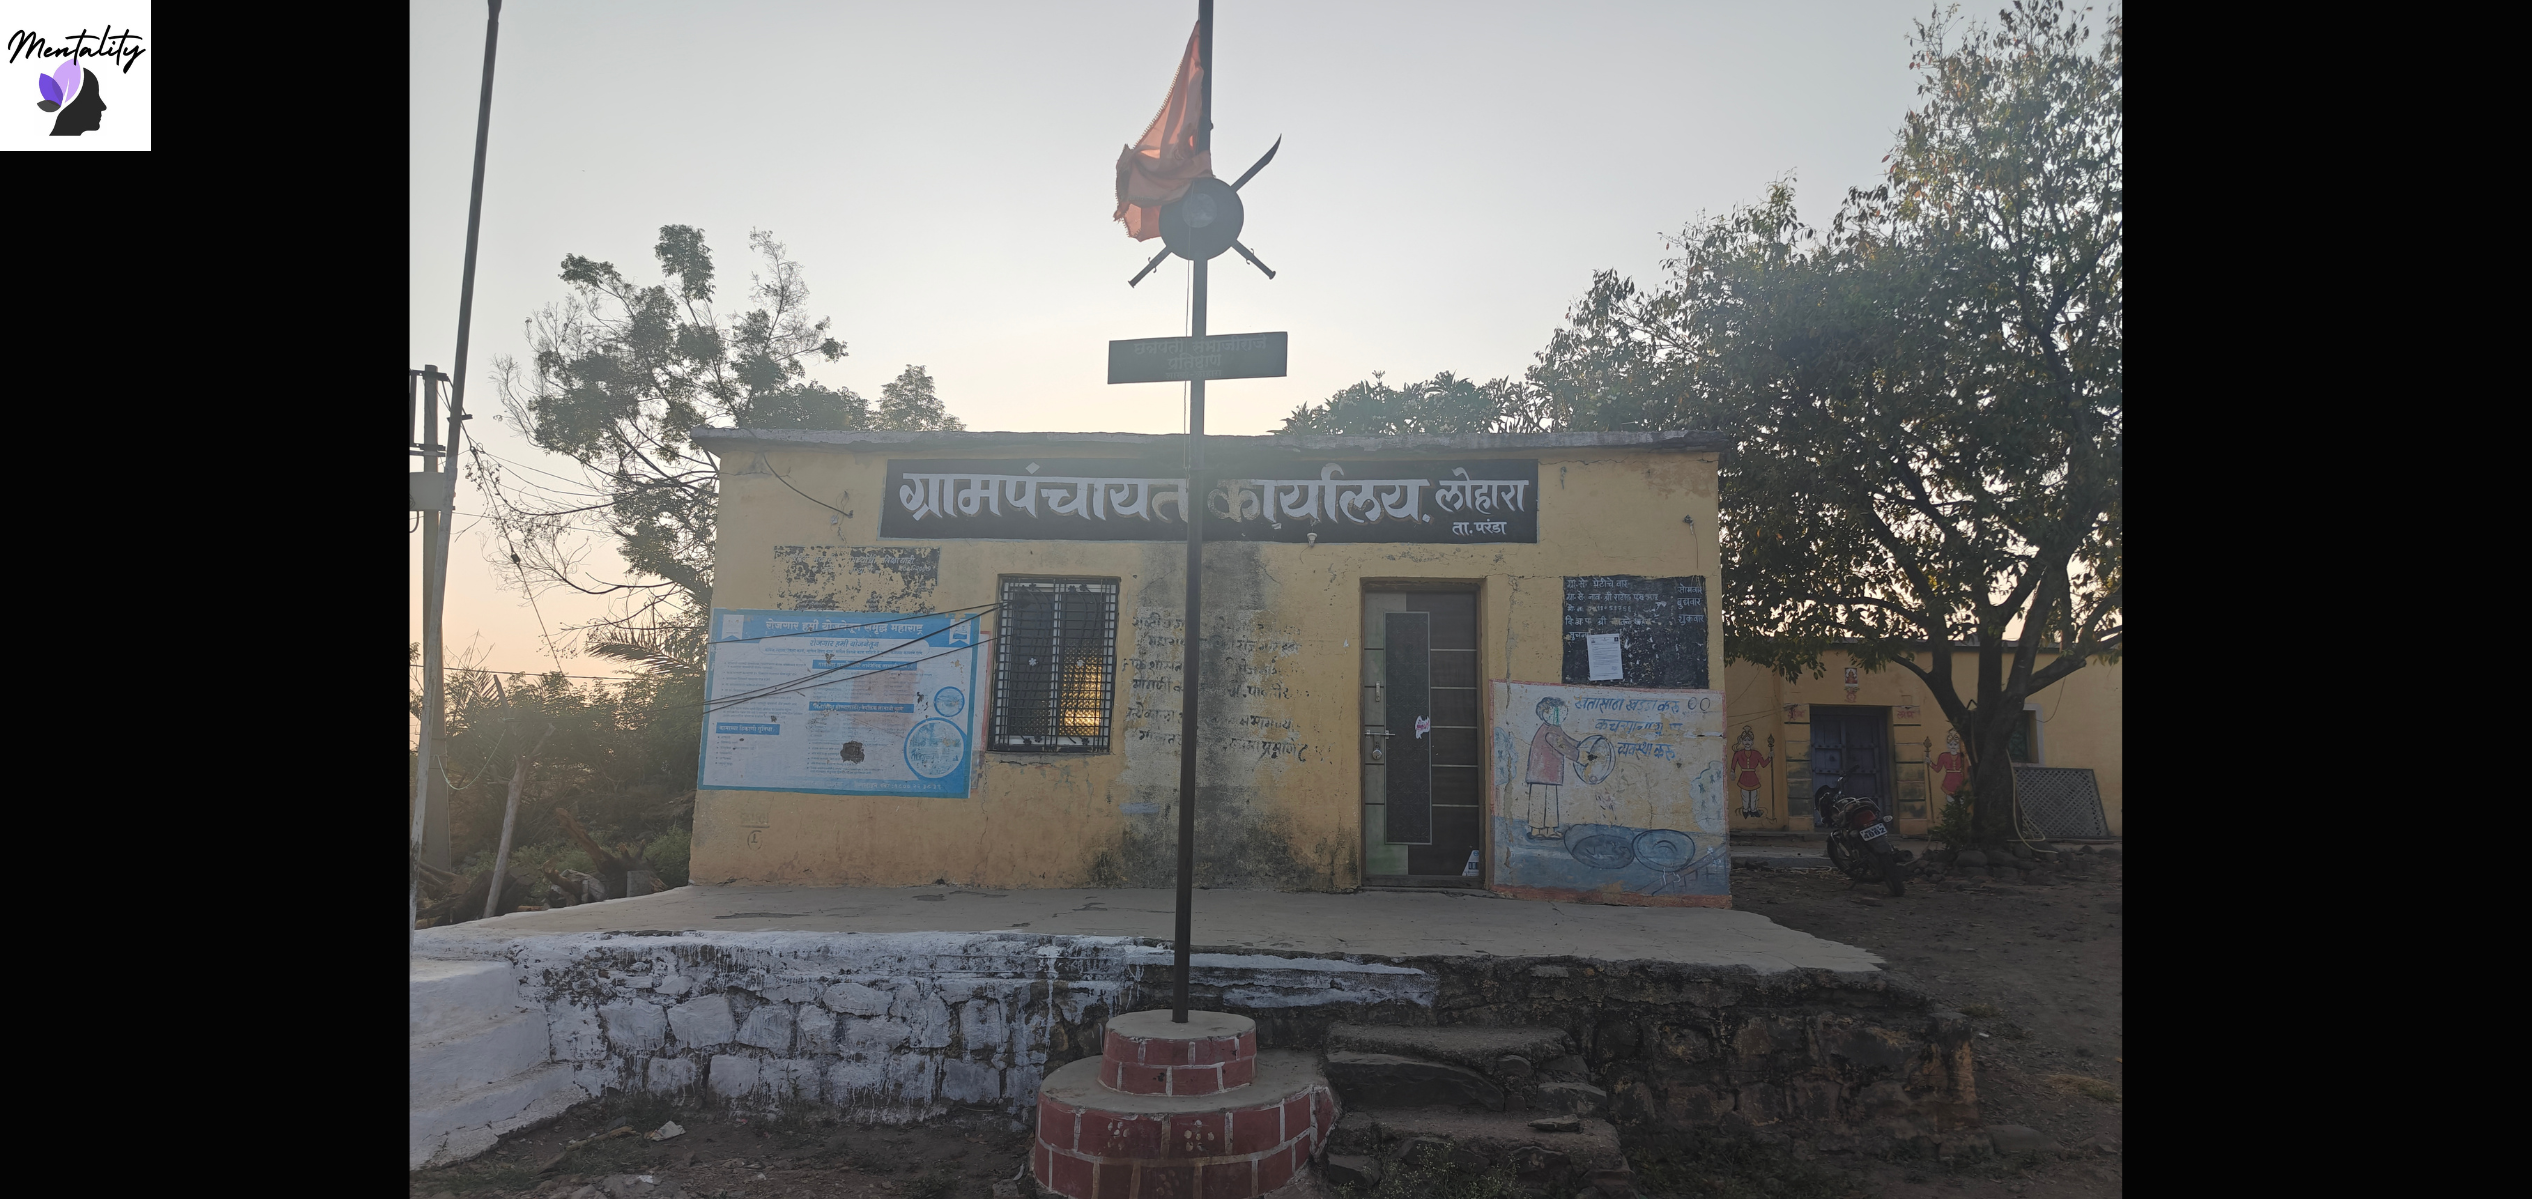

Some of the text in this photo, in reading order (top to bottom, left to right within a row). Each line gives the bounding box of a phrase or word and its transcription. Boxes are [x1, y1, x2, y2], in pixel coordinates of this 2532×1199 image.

[899, 461, 1189, 522] ग्रामपंचायत
[1434, 467, 1528, 515] लोहारा
[765, 618, 799, 631] रोजगार
[802, 619, 819, 632] हमी
[890, 623, 924, 635] महाराष्ट्र
[809, 637, 835, 647] रोजगार
[835, 638, 849, 648] हमी
